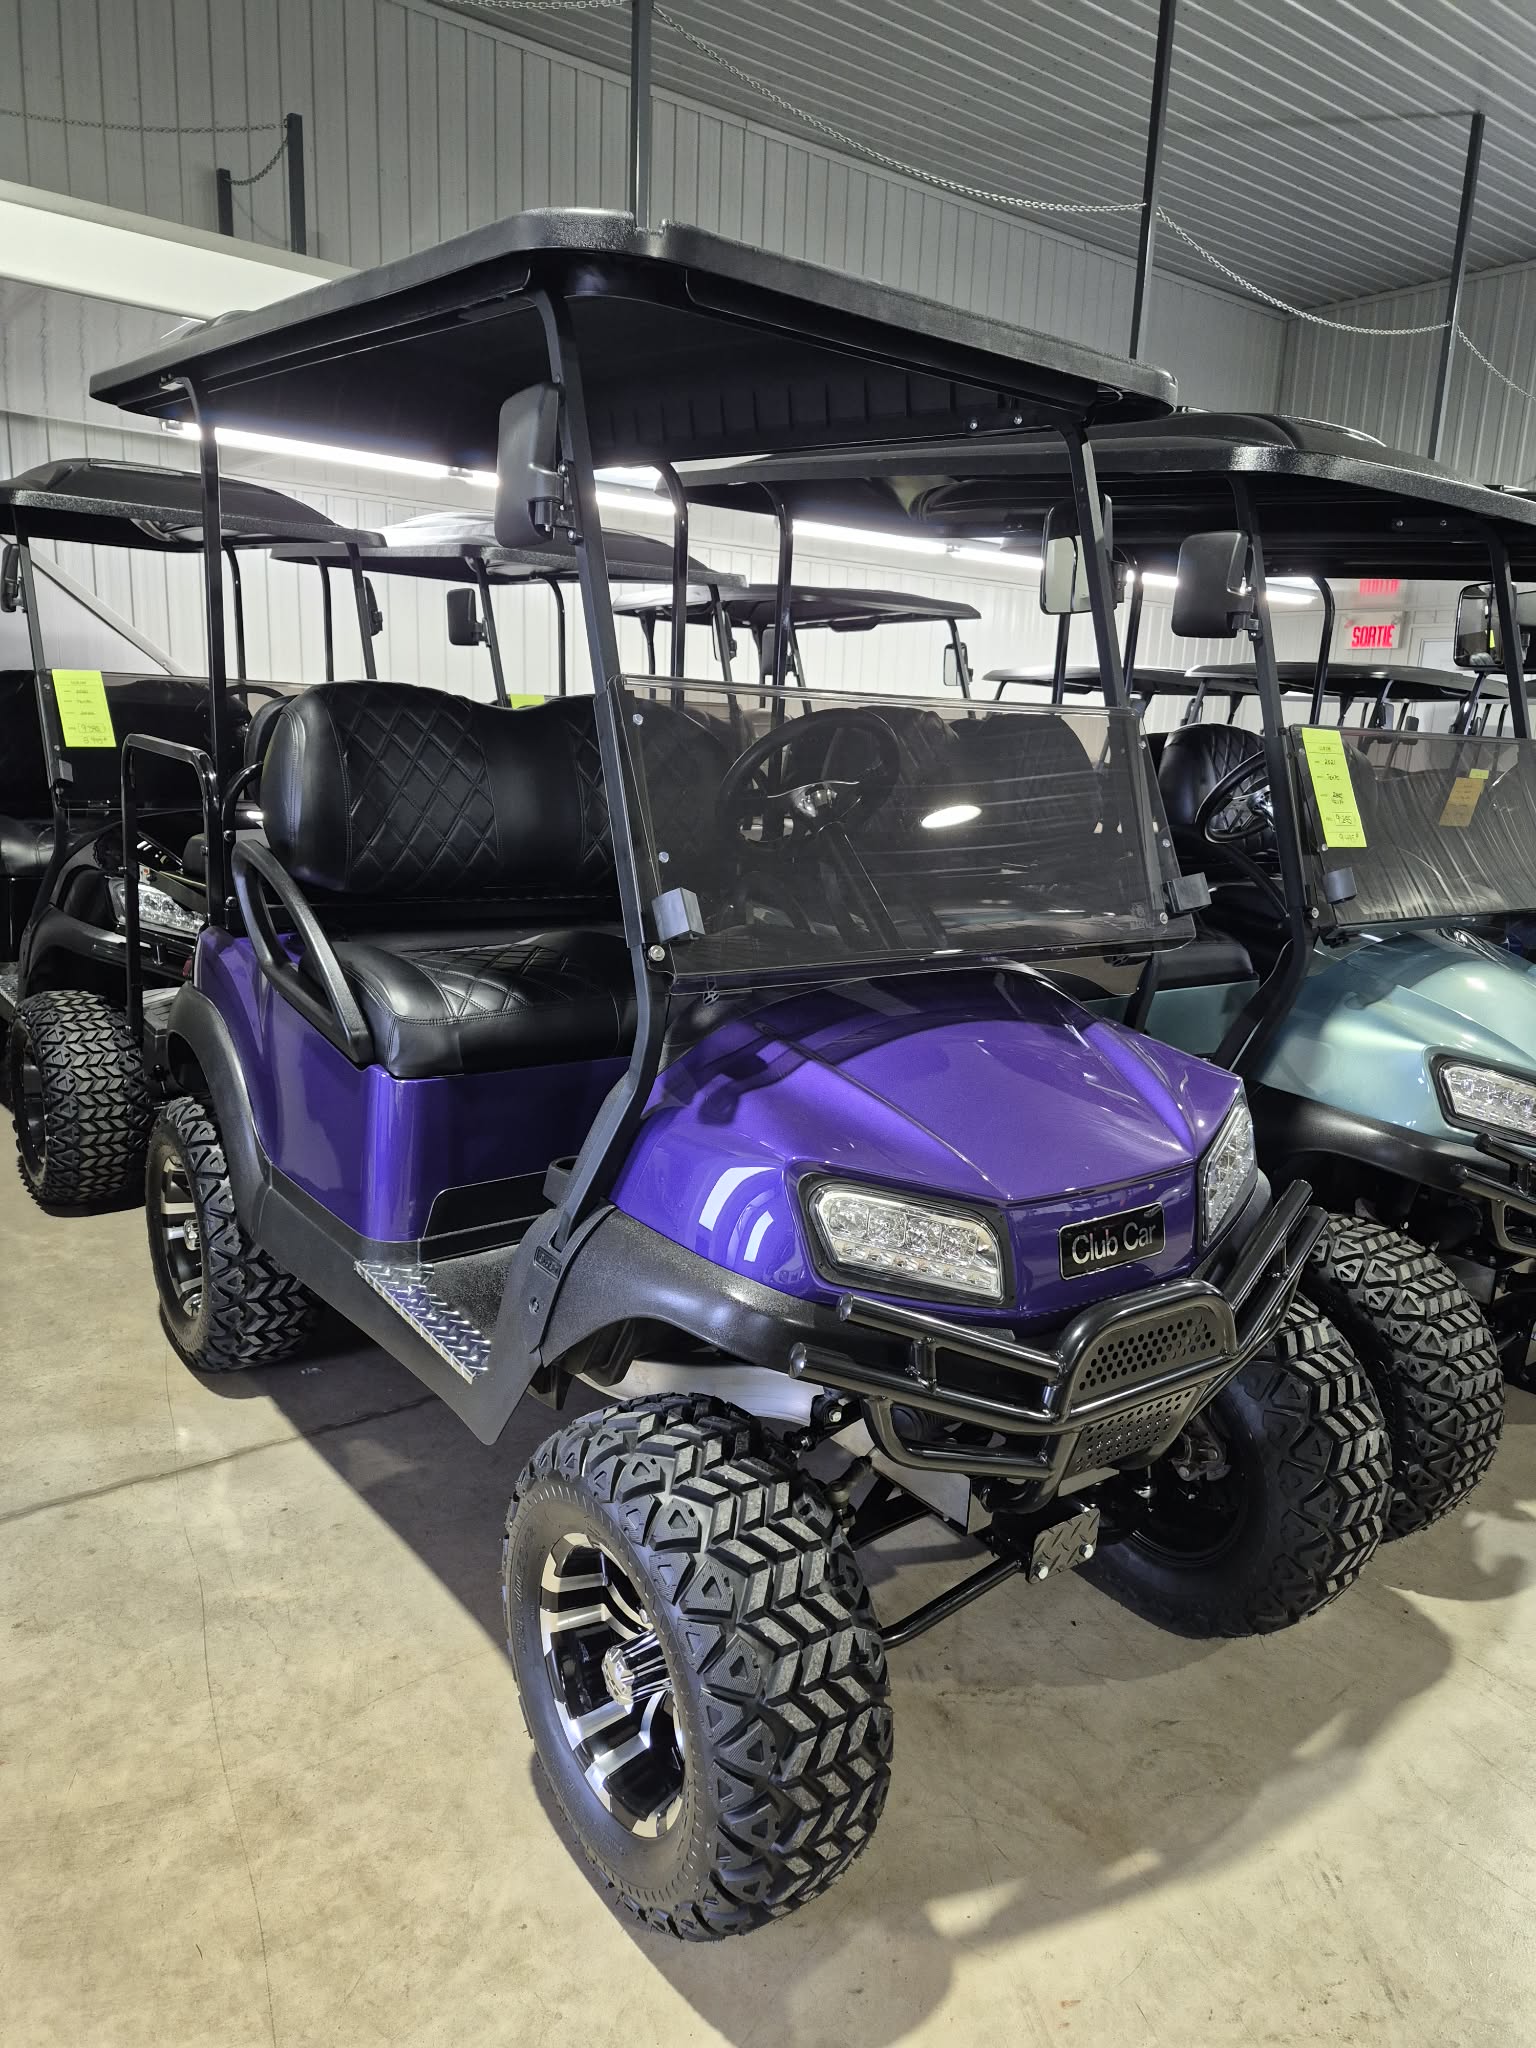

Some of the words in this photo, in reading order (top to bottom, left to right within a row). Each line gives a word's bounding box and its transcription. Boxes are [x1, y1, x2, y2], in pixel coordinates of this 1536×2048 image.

[1351, 624, 1396, 649] SORTIE
[1072, 1229, 1119, 1264] Club
[1123, 1222, 1156, 1251] Car
